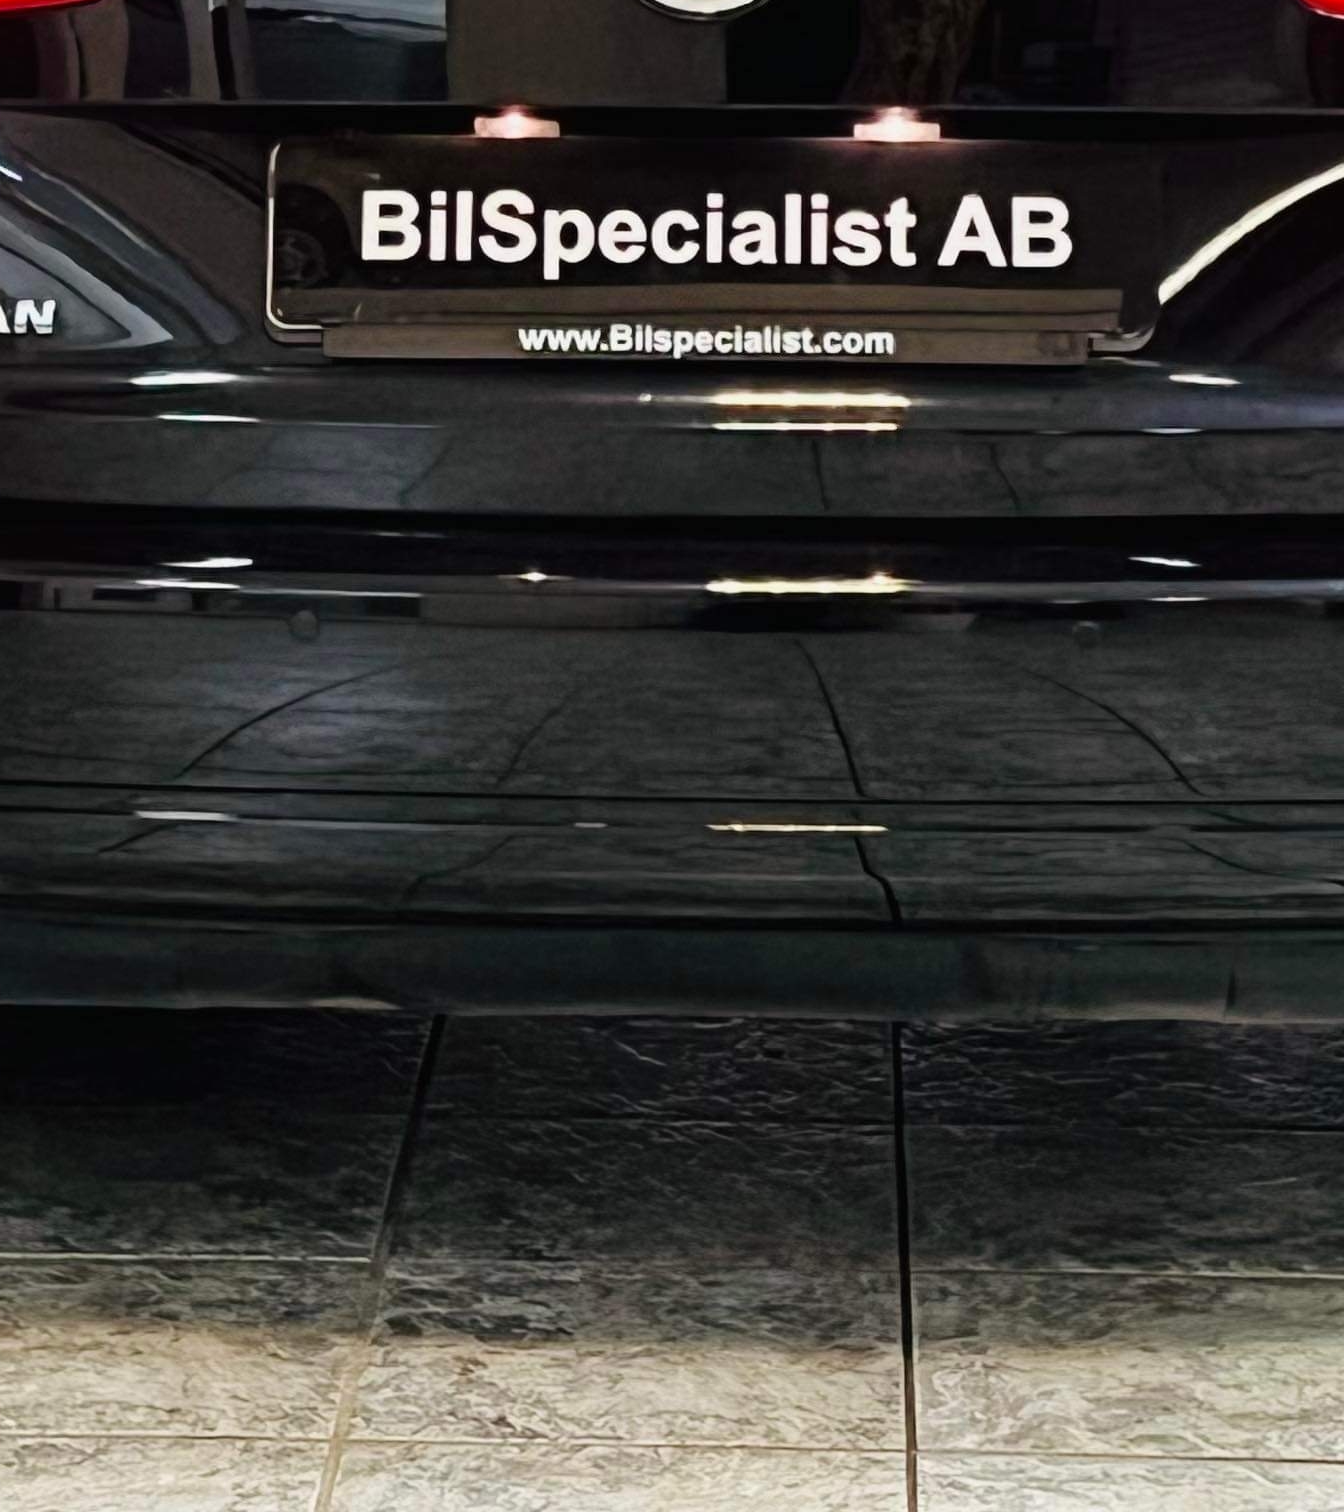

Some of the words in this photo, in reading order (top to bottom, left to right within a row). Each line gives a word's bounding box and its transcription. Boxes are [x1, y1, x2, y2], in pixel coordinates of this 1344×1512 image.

[359, 189, 917, 280] BilSpecialist
[937, 195, 1074, 268] AB
[518, 323, 895, 359] www.Bilspecialist.com
